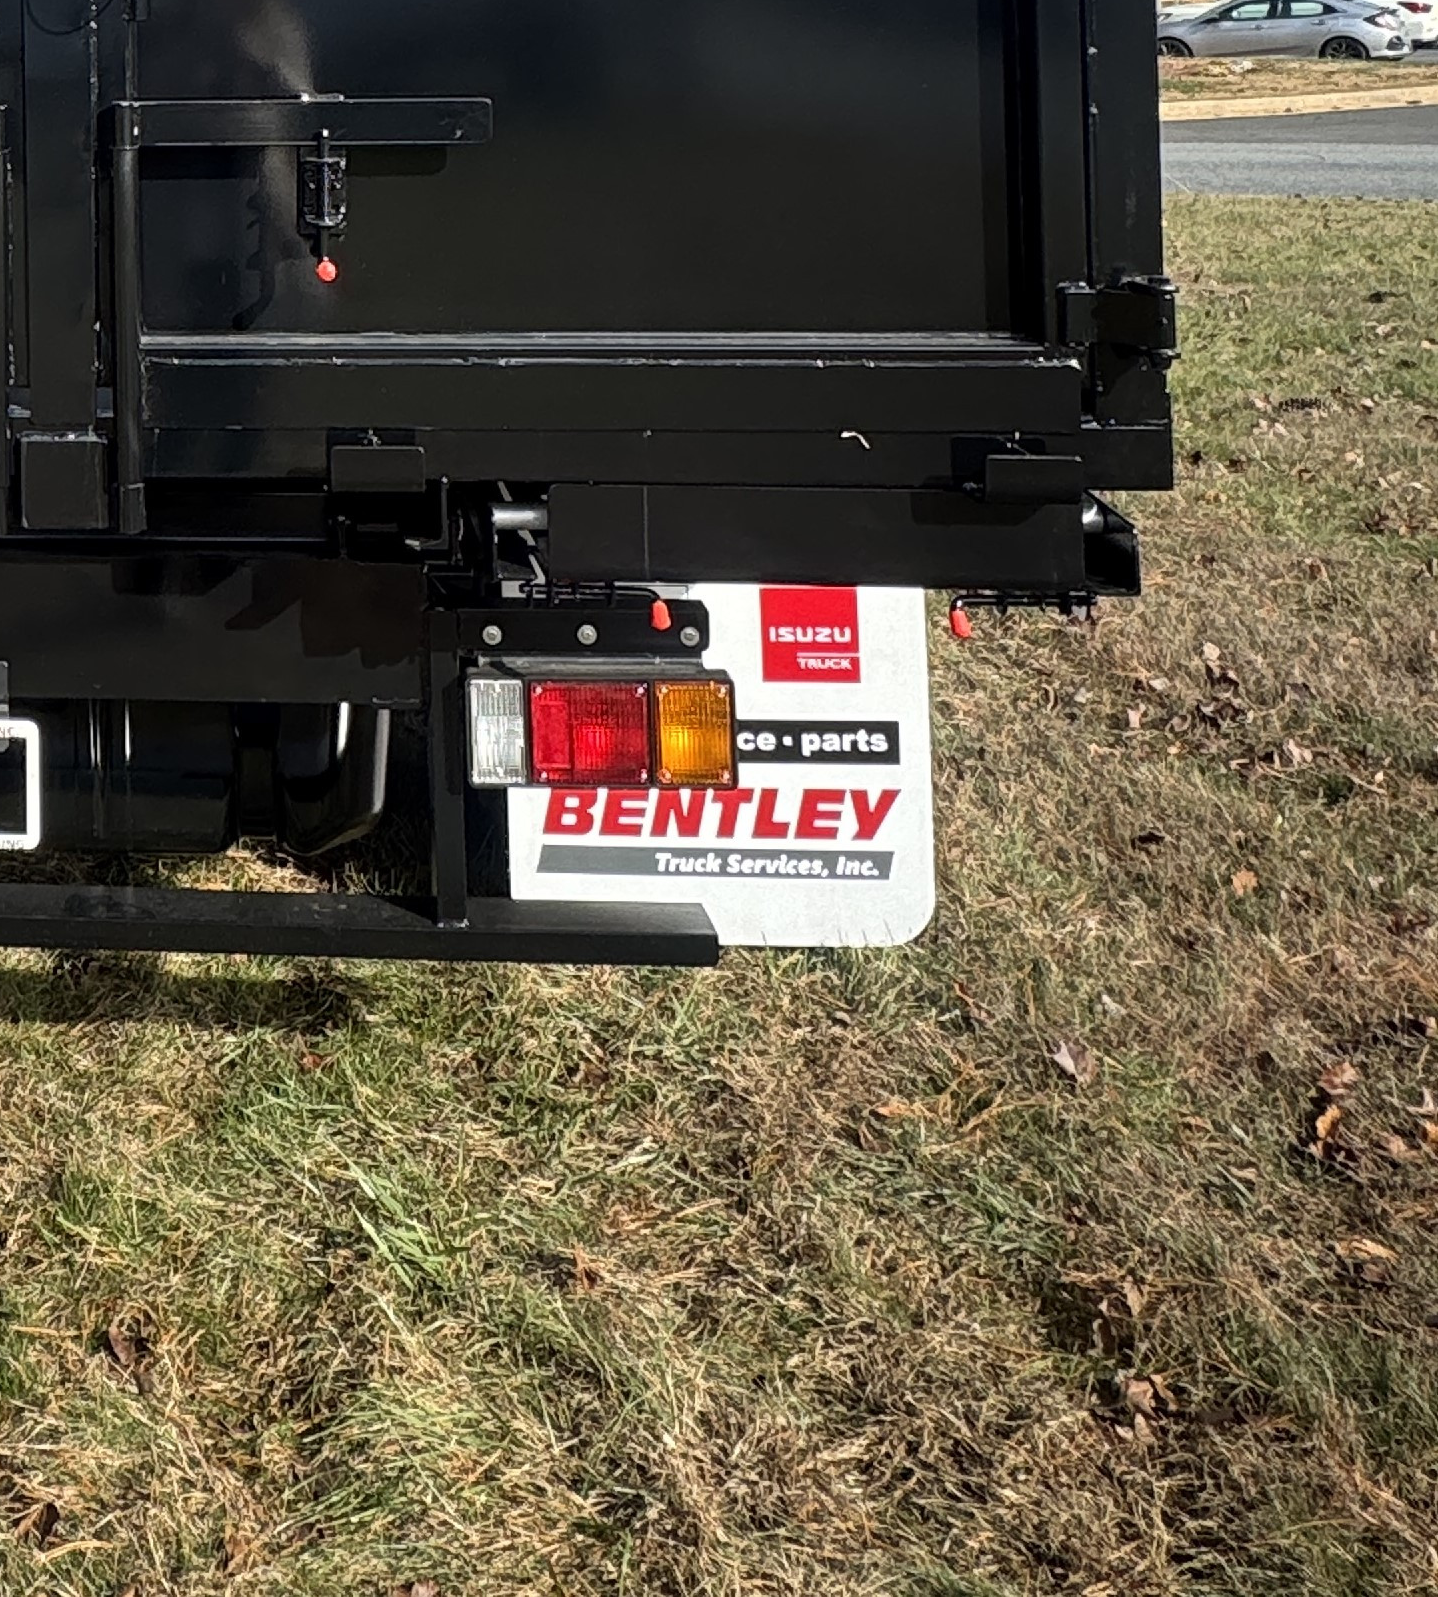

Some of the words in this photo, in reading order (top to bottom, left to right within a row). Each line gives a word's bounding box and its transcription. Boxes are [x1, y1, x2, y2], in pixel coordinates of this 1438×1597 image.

[768, 626, 852, 643] ISUZU
[796, 657, 853, 671] TRUCK
[801, 728, 889, 757] parts
[543, 787, 901, 841] BENTLEY
[655, 852, 722, 873] Truck
[726, 854, 829, 878] Services,
[835, 856, 880, 876] Inc.
